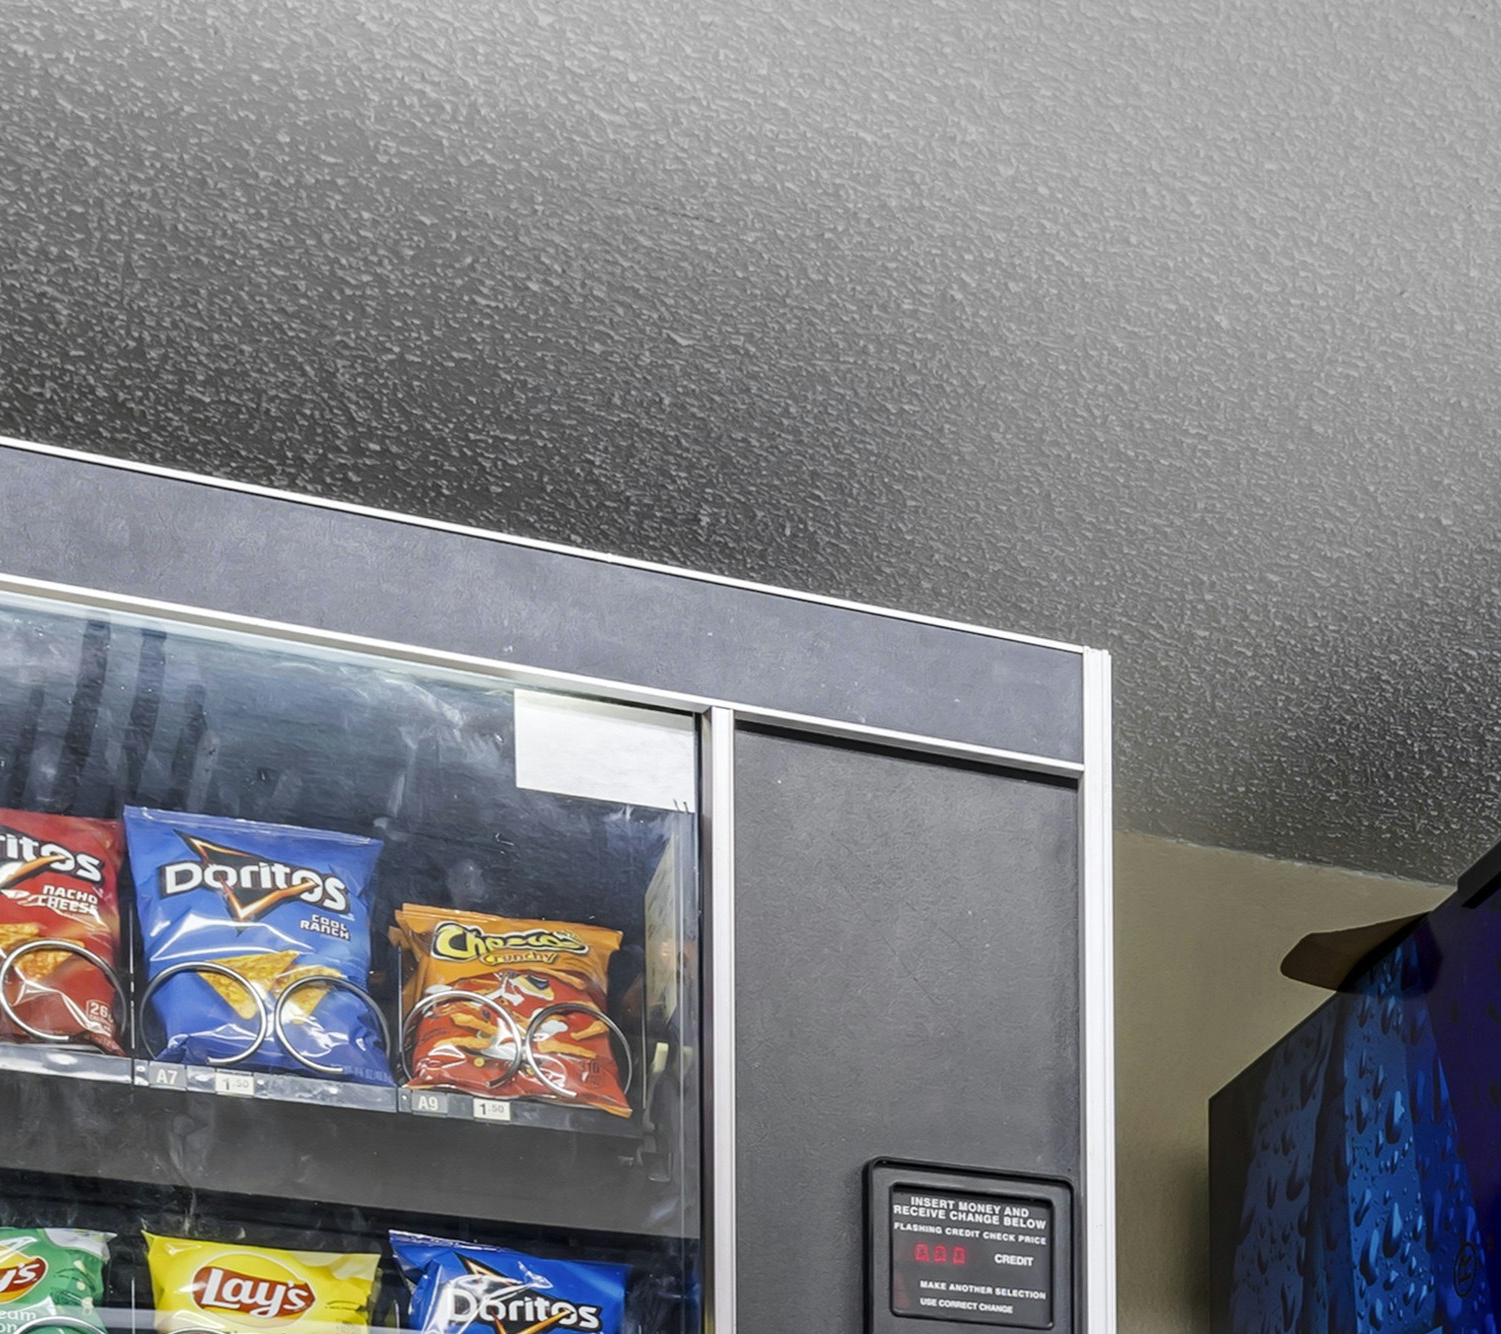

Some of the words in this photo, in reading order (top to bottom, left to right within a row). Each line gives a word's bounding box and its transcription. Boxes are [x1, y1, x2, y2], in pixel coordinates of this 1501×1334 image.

[43, 885, 99, 905] NACHO
[164, 862, 348, 911] Doritos
[37, 895, 99, 915] CHEESE
[300, 920, 350, 940] RANCH
[311, 914, 349, 931] COOL
[485, 951, 556, 965] Crunchy
[156, 1068, 178, 1085] A7
[418, 1096, 438, 1111] A9
[893, 1204, 946, 1219] RECEIVE
[949, 1210, 1000, 1226] CHANGE
[1003, 1215, 1047, 1230] BELOW
[911, 1196, 954, 1210] INSERT
[958, 1201, 1001, 1215] MONEY
[1005, 1206, 1029, 1218] AND
[894, 1222, 943, 1235] FLASHING
[945, 1227, 980, 1239] CREDIT
[983, 1232, 1016, 1242] CHECK
[1018, 1234, 1047, 1246] PRICE
[994, 1253, 1034, 1267] CREDIT
[200, 1267, 309, 1318] Lay's
[920, 1280, 947, 1291] MAKE
[949, 1283, 993, 1295] ANOTHER
[994, 1288, 1047, 1300] SELECTION
[450, 1287, 600, 1329] Doritos
[920, 1298, 937, 1308] USE
[938, 1299, 978, 1311] CORRECT
[979, 1303, 1014, 1314] CHANGE
